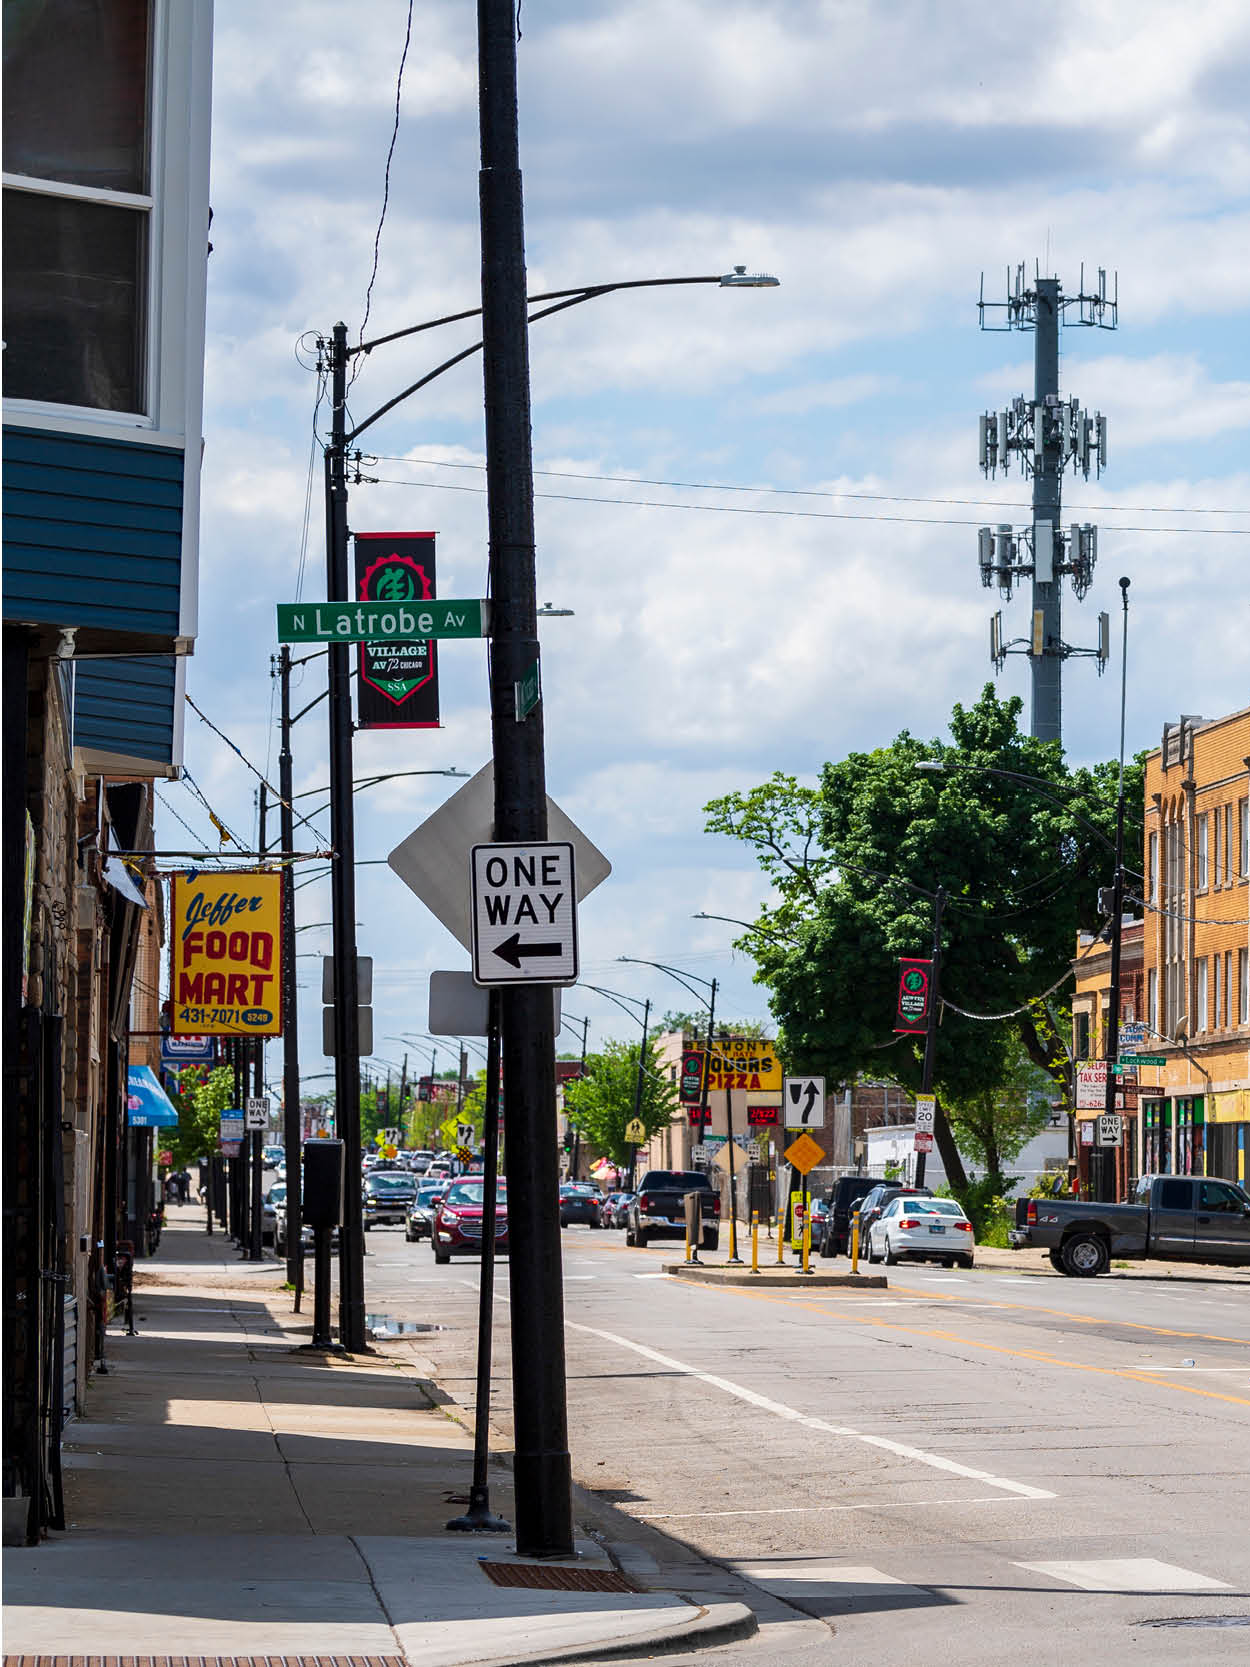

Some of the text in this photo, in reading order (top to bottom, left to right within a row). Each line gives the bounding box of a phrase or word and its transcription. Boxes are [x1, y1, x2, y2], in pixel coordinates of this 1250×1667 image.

[294, 608, 466, 635] N Latrobe Av
[367, 646, 427, 657] VILLAGE
[372, 661, 387, 670] AV
[387, 658, 399, 672] 72
[387, 682, 407, 692] SSA
[486, 855, 561, 888] ONE
[484, 893, 564, 925] WAY
[182, 892, 263, 941] Jeffer
[183, 931, 273, 971] FOOD
[179, 972, 274, 1006] MART
[179, 1007, 240, 1023] 431-7071
[1126, 1057, 1157, 1065] Lockwood
[708, 1074, 761, 1089] PIZZA
[1080, 1072, 1093, 1082] TAX
[249, 1109, 267, 1117] WAY
[918, 1112, 932, 1121] 20
[132, 1116, 147, 1125] 5301
[1101, 1118, 1119, 1126] ONE
